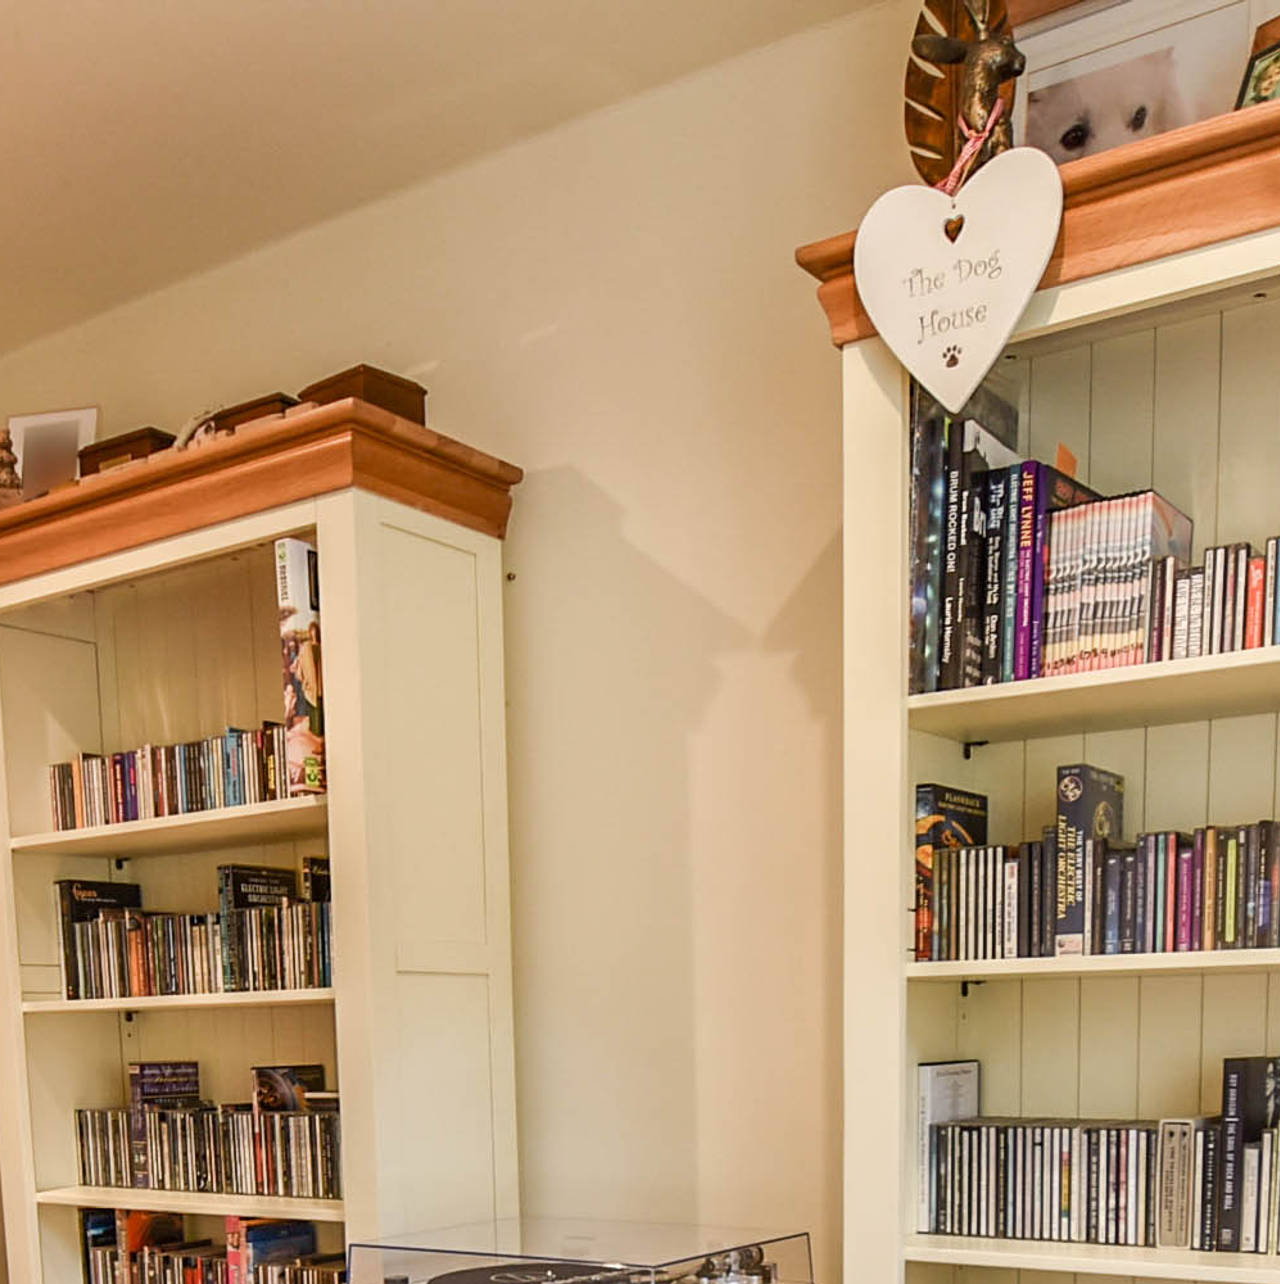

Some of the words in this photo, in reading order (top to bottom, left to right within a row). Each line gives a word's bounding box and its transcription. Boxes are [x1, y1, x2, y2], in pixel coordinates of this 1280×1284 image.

[902, 267, 945, 298] The
[952, 248, 1003, 283] Dog
[917, 304, 988, 345] House
[948, 470, 959, 503] BRUM
[1022, 472, 1033, 502] JEFF
[948, 504, 958, 550] ROCKED
[1020, 505, 1033, 547] LYNNE
[944, 597, 954, 625] Laurie
[1058, 814, 1068, 849] LIGHT
[1067, 826, 1076, 850] THE
[1057, 852, 1066, 920] ORCHESTRA
[1067, 852, 1076, 906] ELECTRIC
[1076, 891, 1083, 901] OF
[1224, 1194, 1233, 1210] ROLL
[1225, 1181, 1234, 1194] AND
